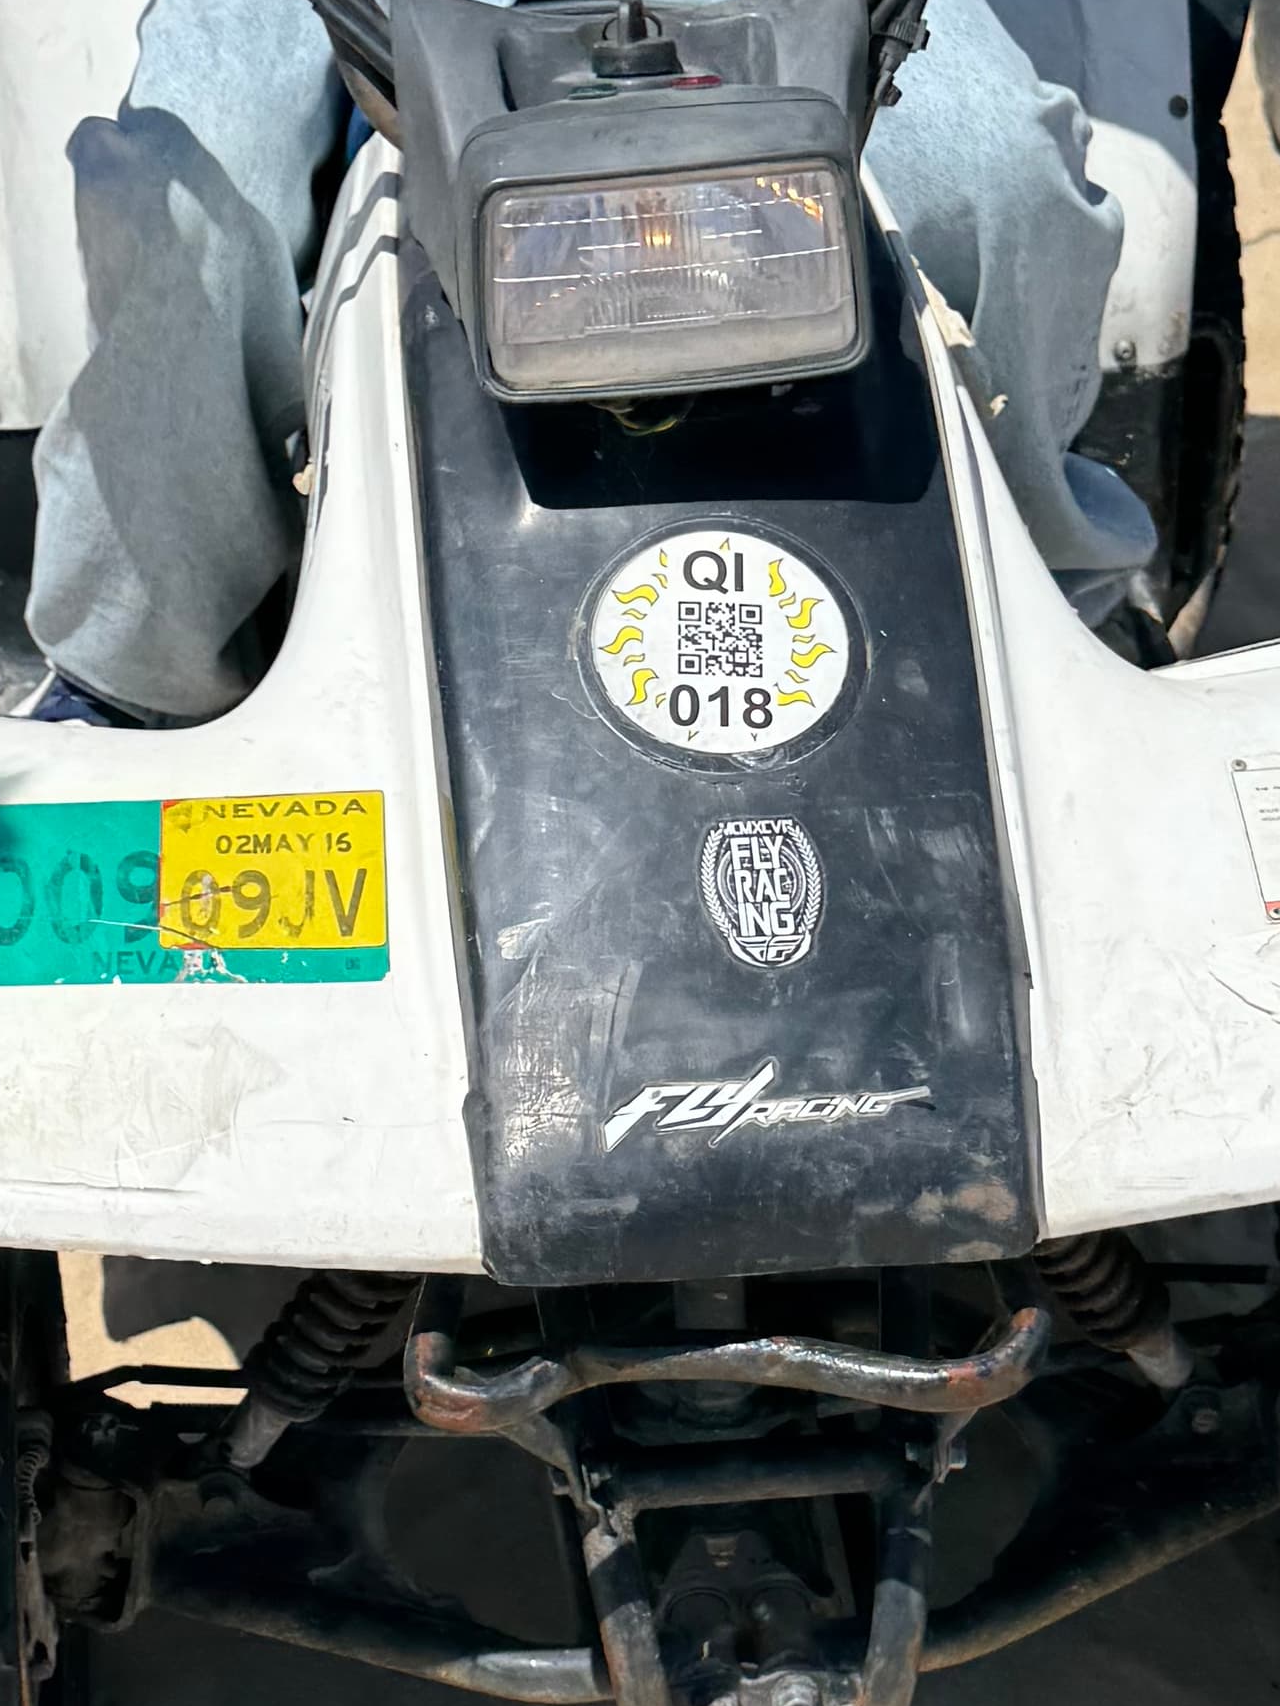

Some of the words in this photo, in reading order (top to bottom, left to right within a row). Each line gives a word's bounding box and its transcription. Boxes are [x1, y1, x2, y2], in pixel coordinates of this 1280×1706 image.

[682, 550, 745, 594] QI
[668, 684, 773, 729] 018
[204, 798, 367, 819] NEVADA
[730, 835, 783, 870] FLY
[734, 868, 791, 902] RAC
[738, 901, 795, 936] ING
[604, 1061, 775, 1151] FLY
[751, 1091, 910, 1125] RACING
